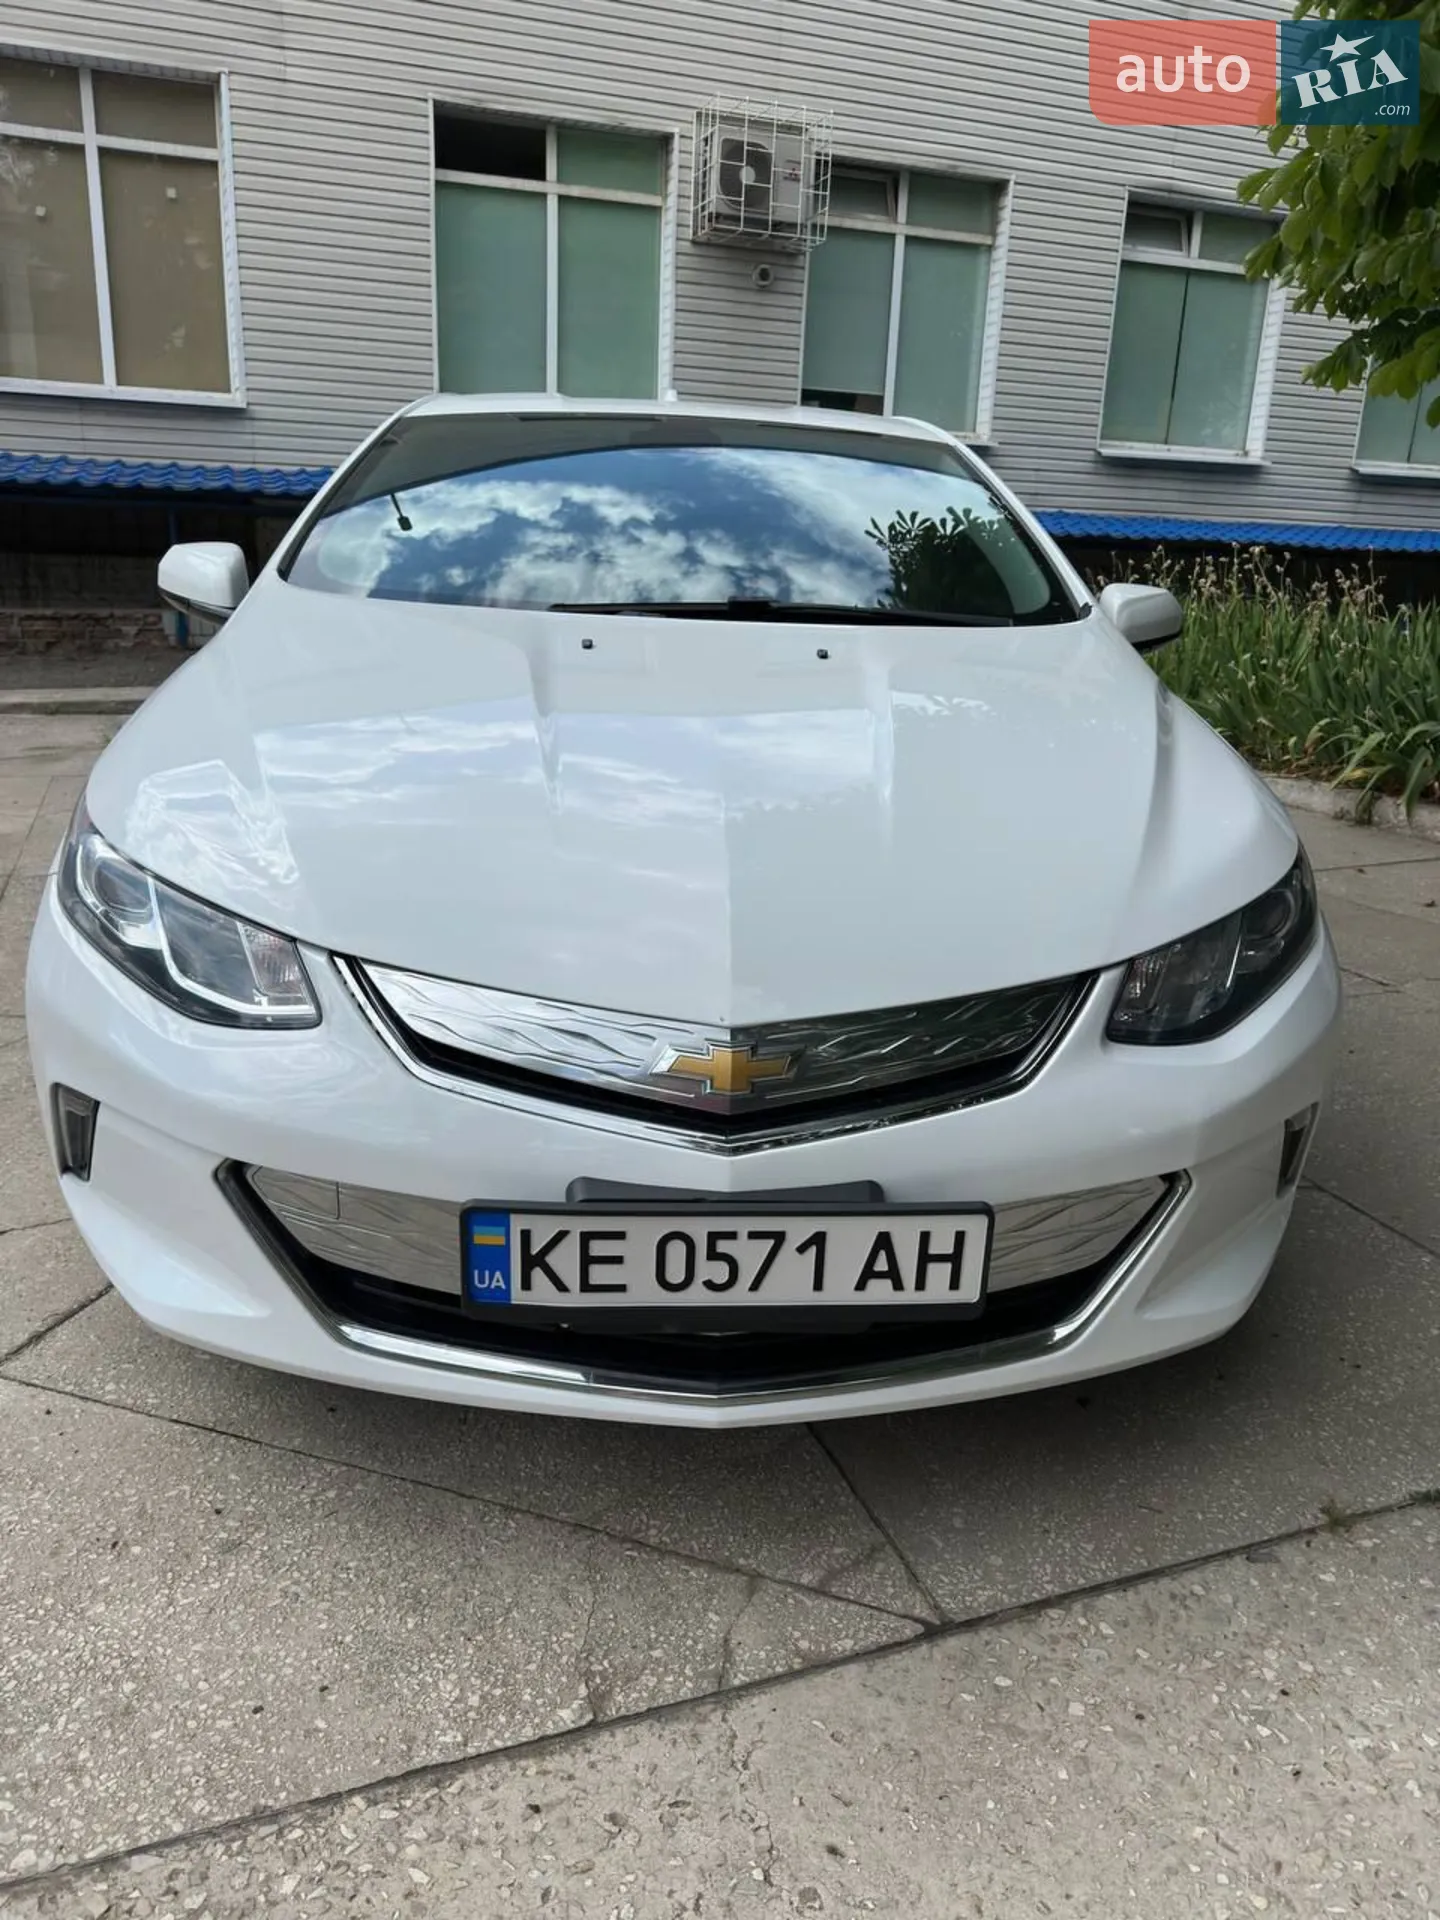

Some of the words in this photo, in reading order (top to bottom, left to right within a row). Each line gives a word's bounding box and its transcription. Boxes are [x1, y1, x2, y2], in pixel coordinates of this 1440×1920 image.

[473, 1270, 507, 1291] UA
[518, 1229, 627, 1294] KE
[655, 1230, 827, 1293] 0571
[853, 1230, 967, 1293] AH
